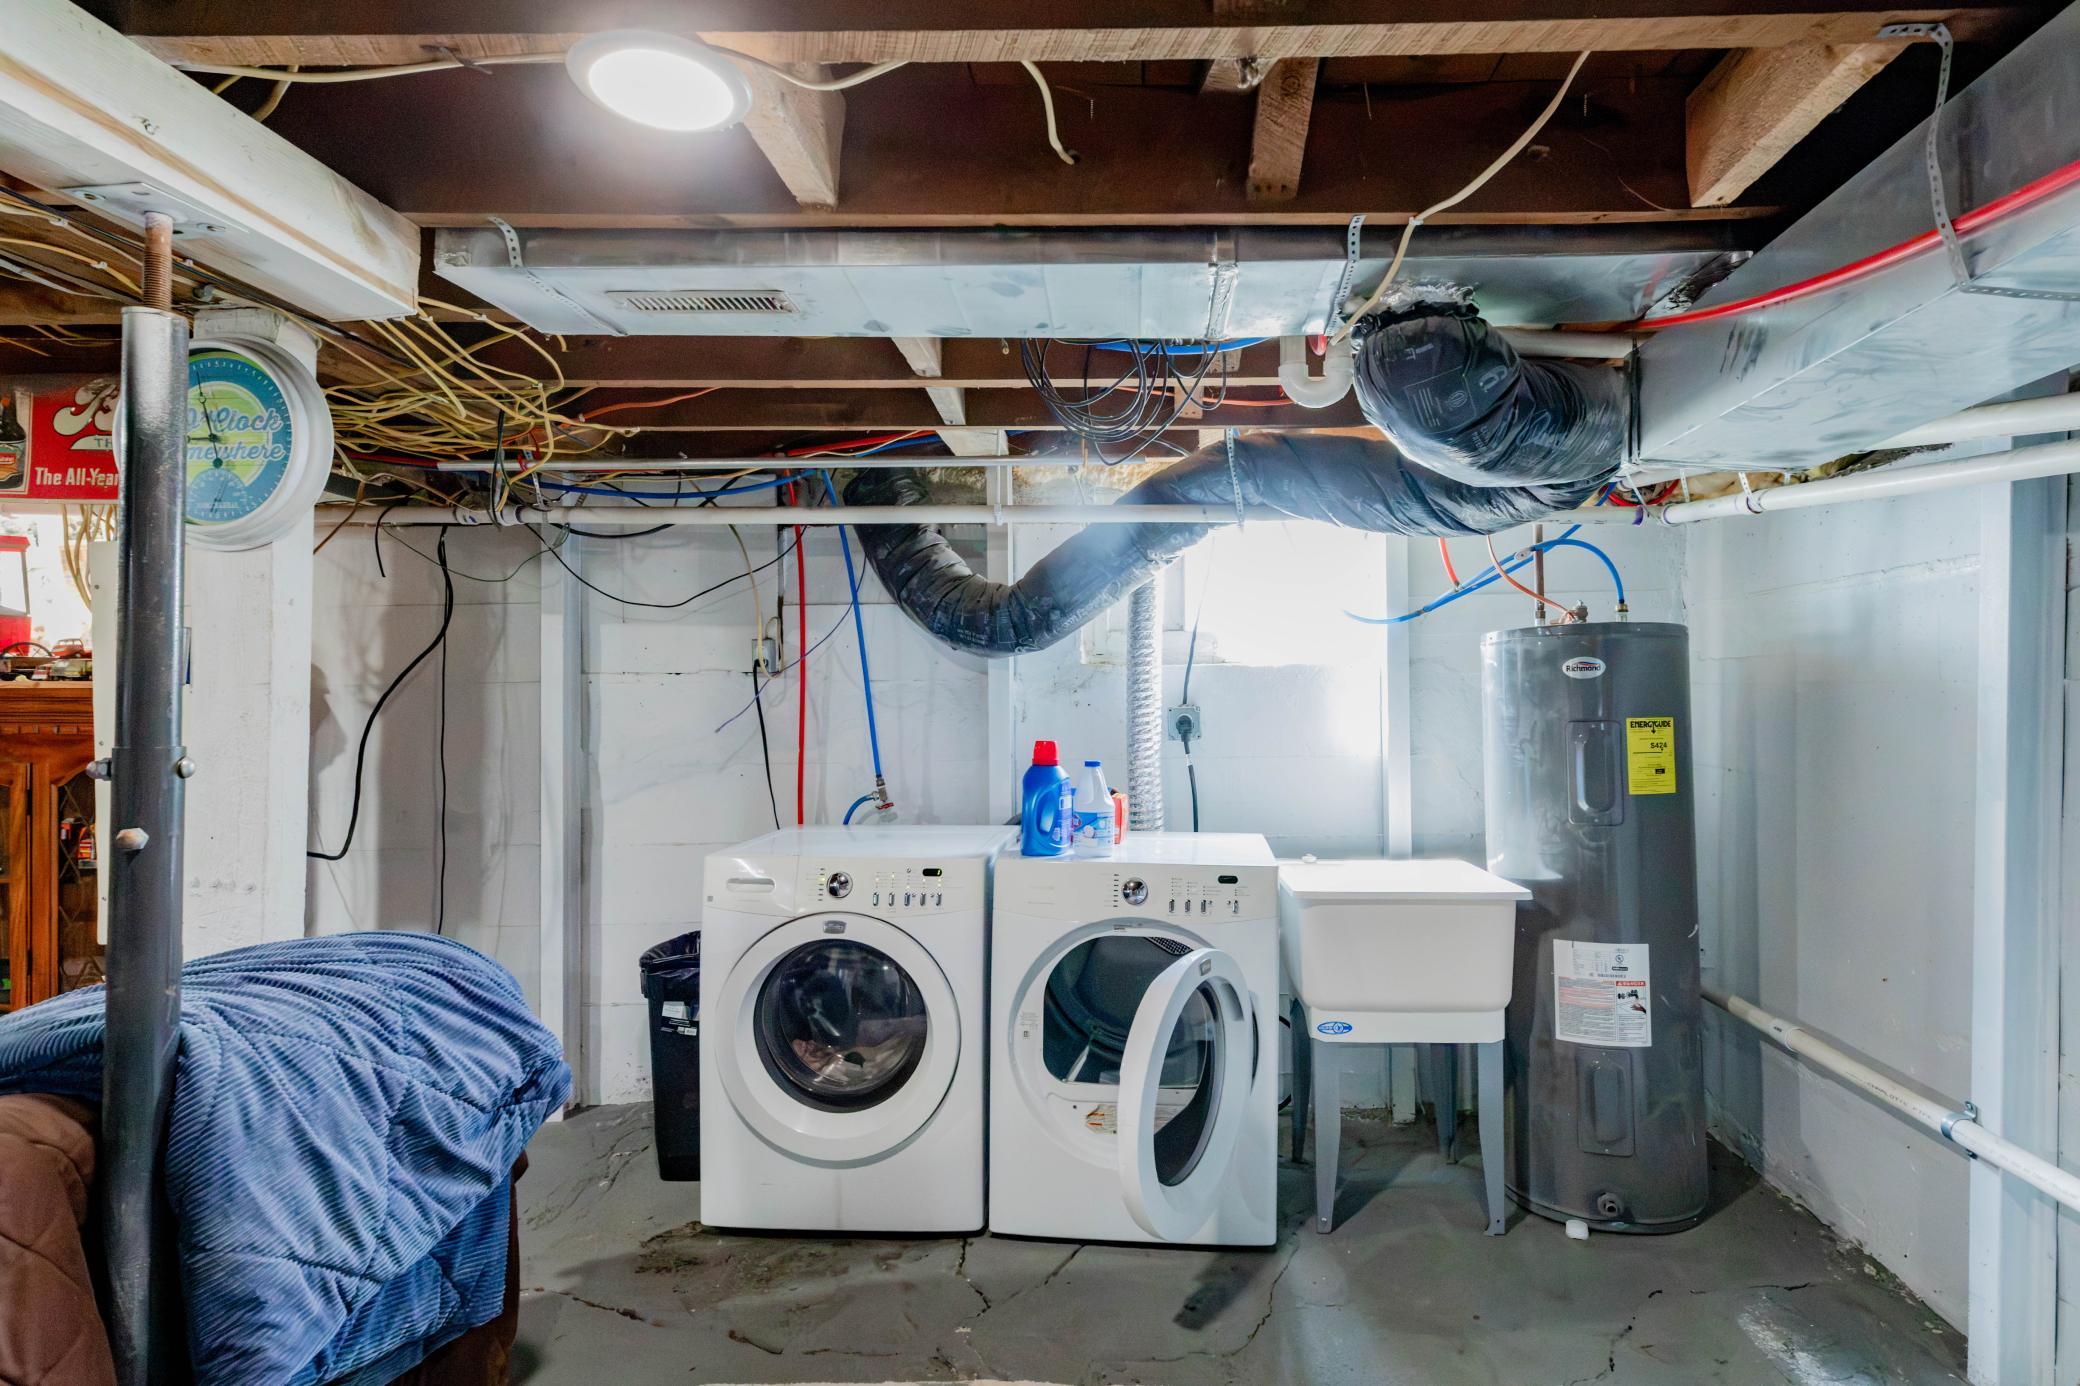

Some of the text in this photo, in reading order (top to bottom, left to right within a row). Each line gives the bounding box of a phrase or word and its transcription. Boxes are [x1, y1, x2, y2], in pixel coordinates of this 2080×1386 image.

[187, 441, 287, 461] mewhere
[35, 467, 62, 486] The
[1565, 663, 1601, 672] Richmond
